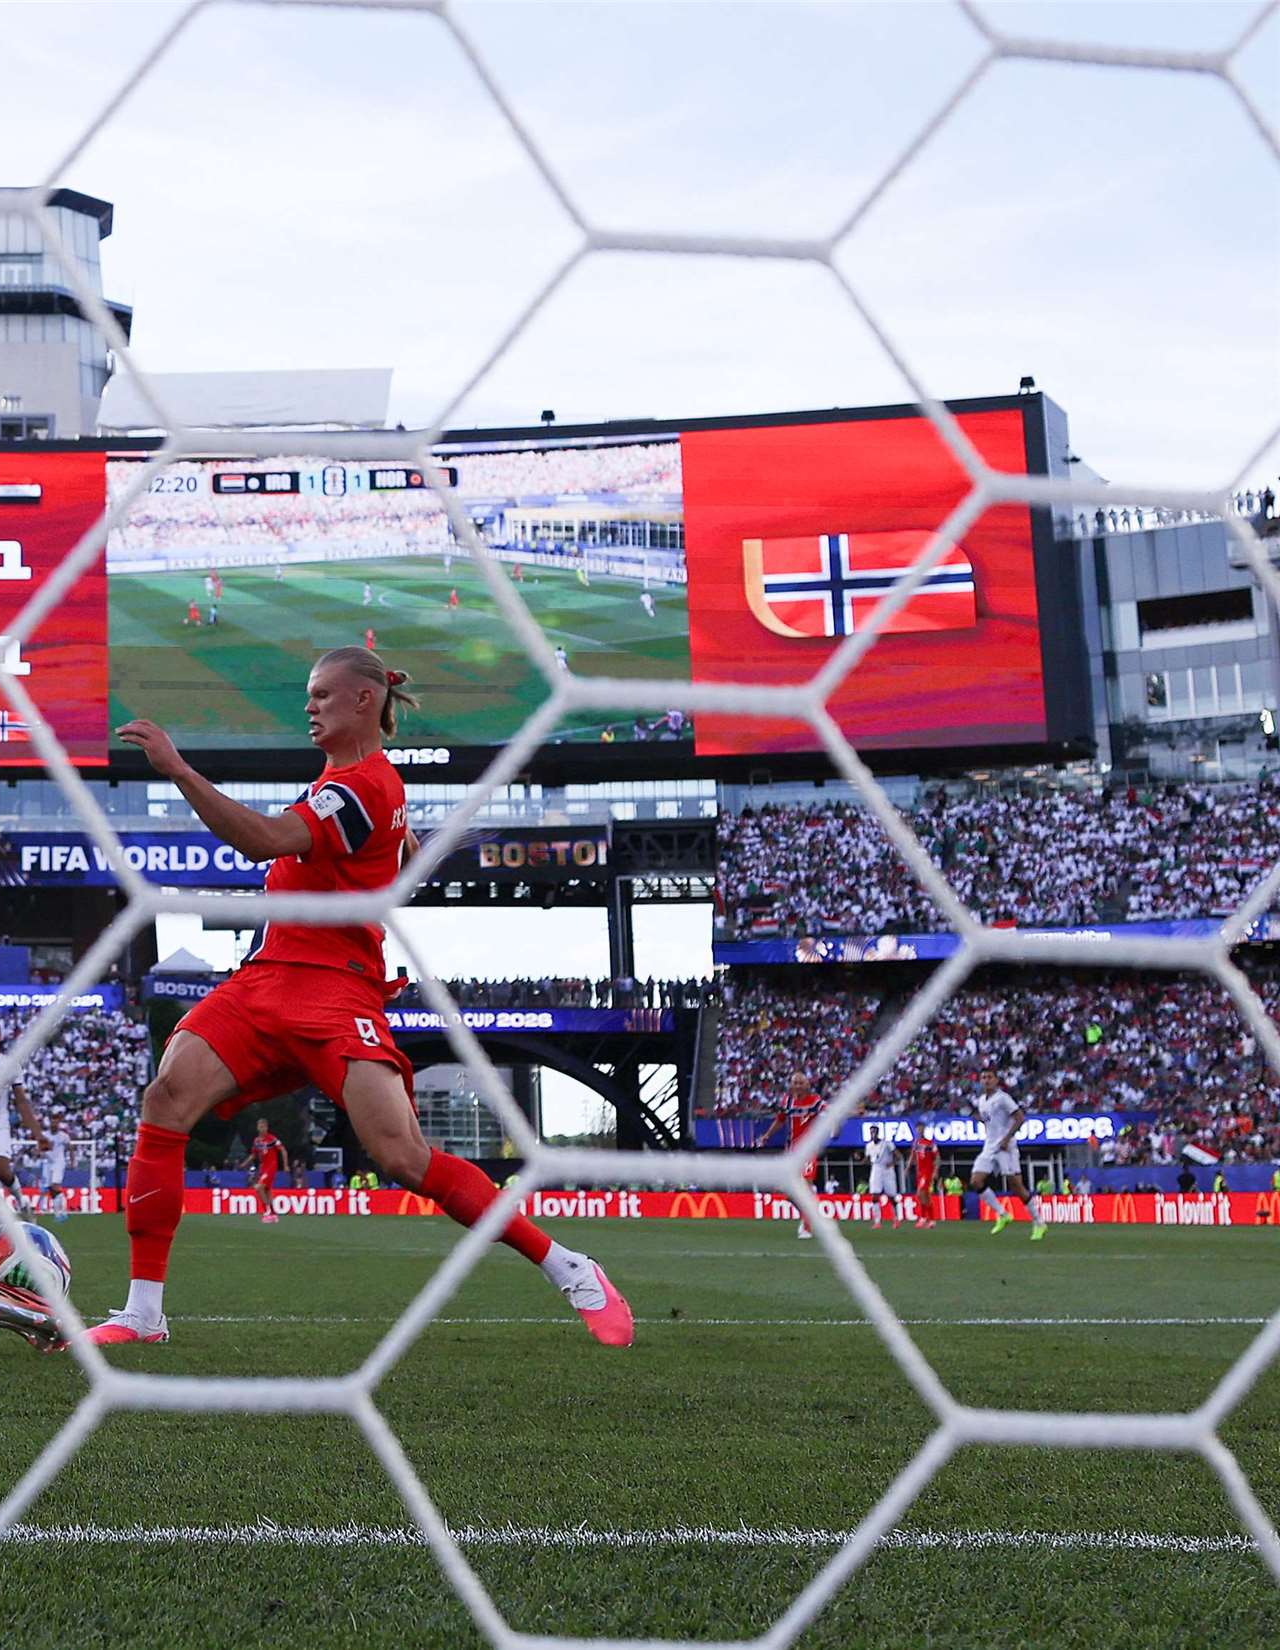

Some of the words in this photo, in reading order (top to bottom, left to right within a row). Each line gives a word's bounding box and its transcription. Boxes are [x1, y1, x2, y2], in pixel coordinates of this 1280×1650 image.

[147, 476, 198, 493] 2:20
[384, 747, 450, 765] ense
[21, 846, 89, 872] FIFA
[214, 845, 267, 872] CU
[153, 981, 214, 998] BOSTO
[463, 1012, 495, 1028] CUP
[923, 1120, 987, 1142] ORL
[212, 1188, 257, 1215] i'm
[272, 1188, 343, 1215] ovin'
[348, 1188, 372, 1215] it
[533, 1191, 613, 1218] lovin'
[619, 1191, 642, 1218] it
[754, 1193, 801, 1220] i'm
[818, 1193, 889, 1220] ovin'
[894, 1193, 918, 1221] it
